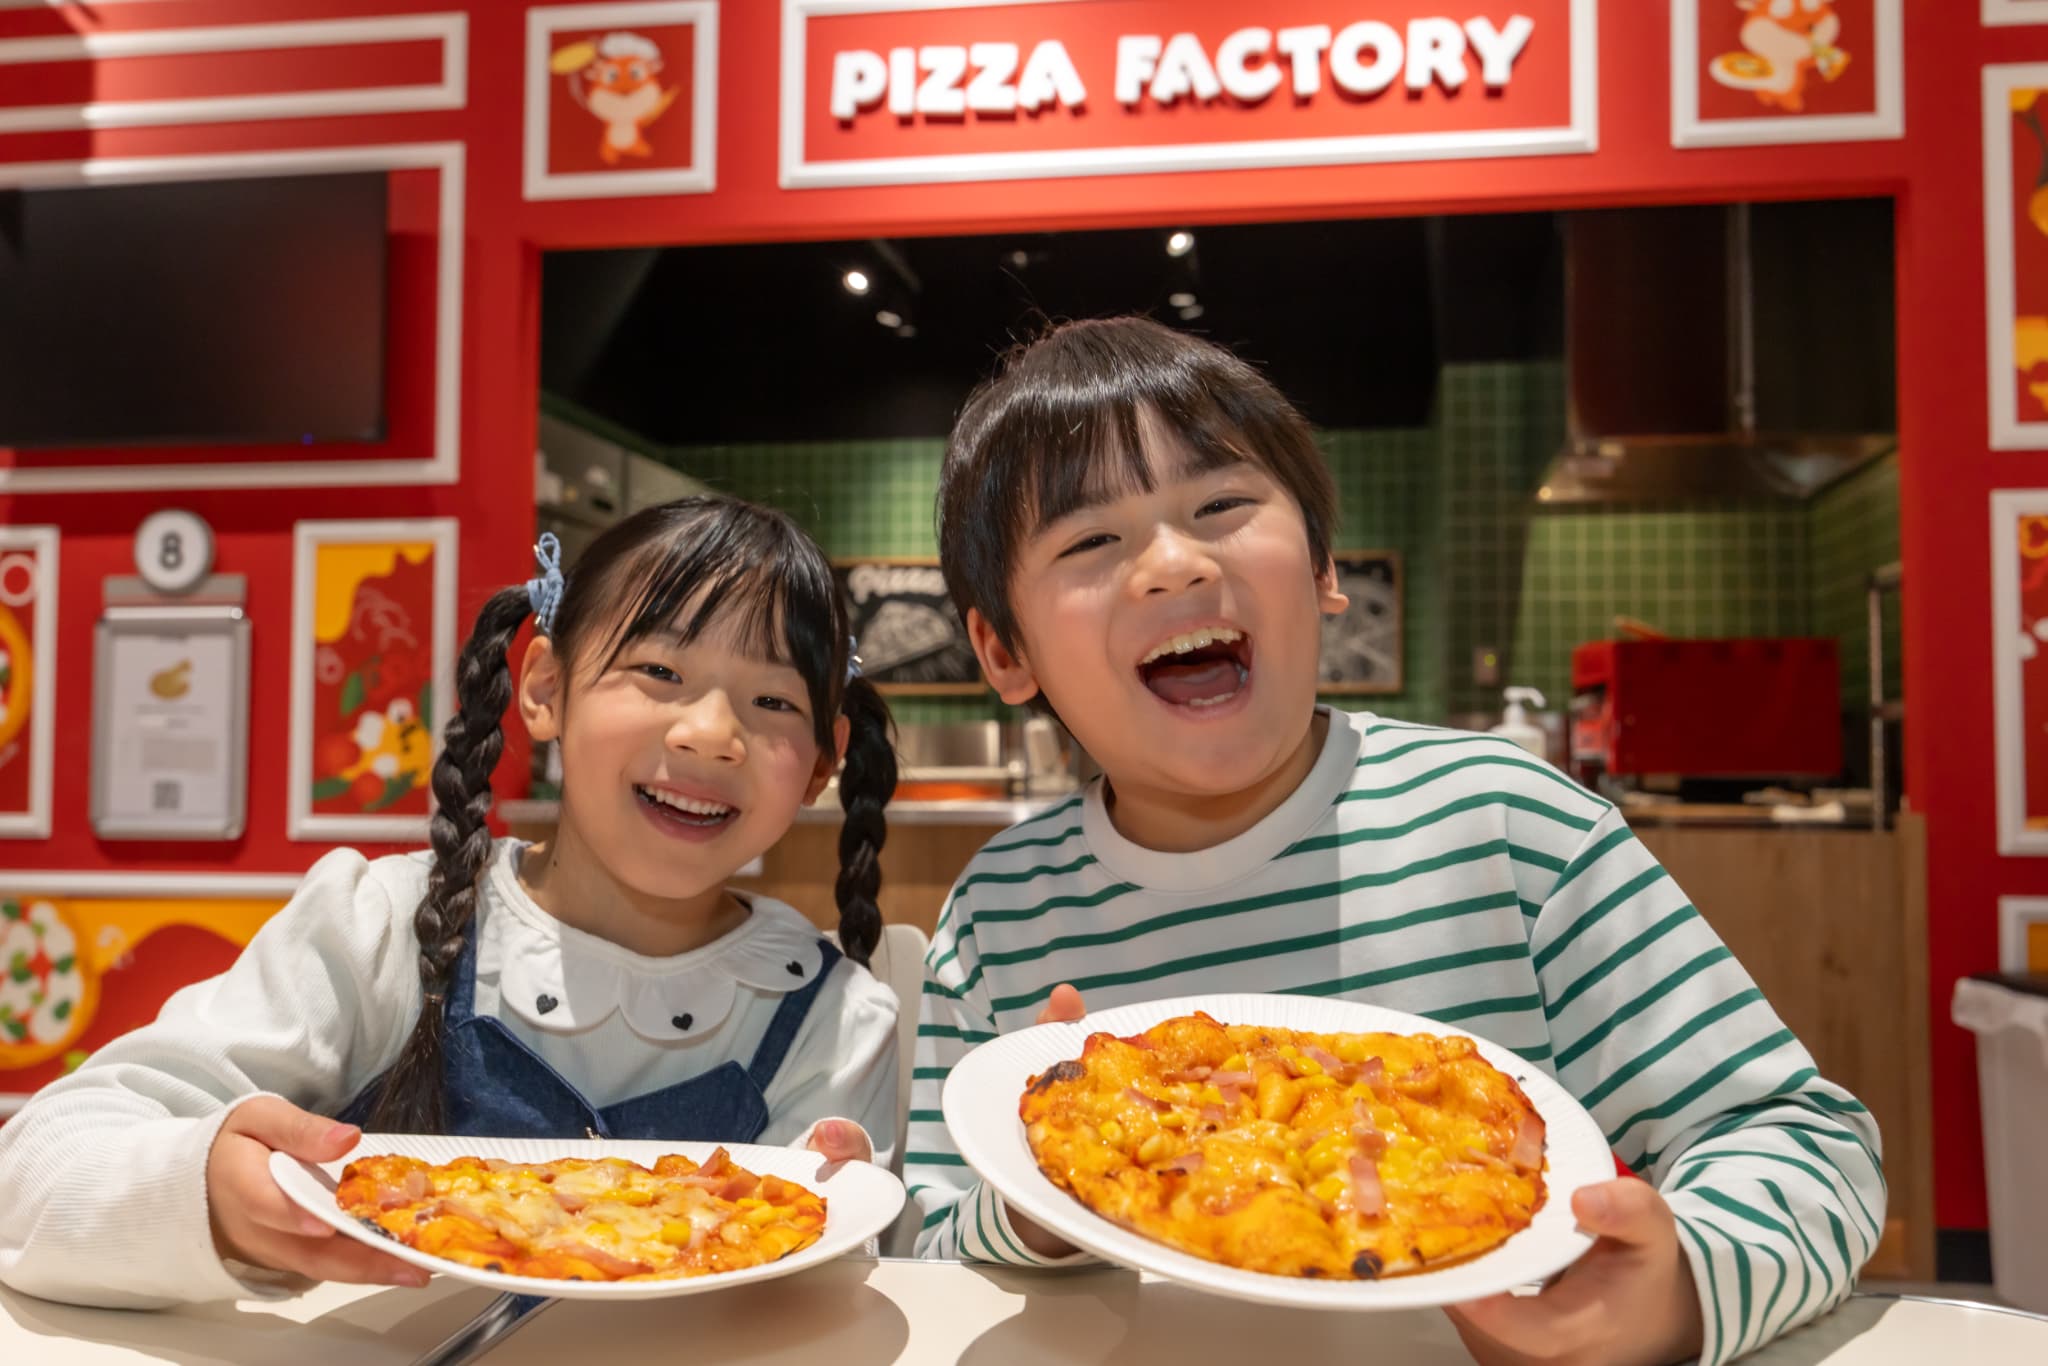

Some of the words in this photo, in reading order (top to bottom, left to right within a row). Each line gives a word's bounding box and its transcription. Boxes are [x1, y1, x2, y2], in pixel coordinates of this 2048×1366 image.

[831, 39, 1088, 120] PIZZA
[1114, 15, 1535, 104] FACTORY
[160, 531, 183, 570] 8
